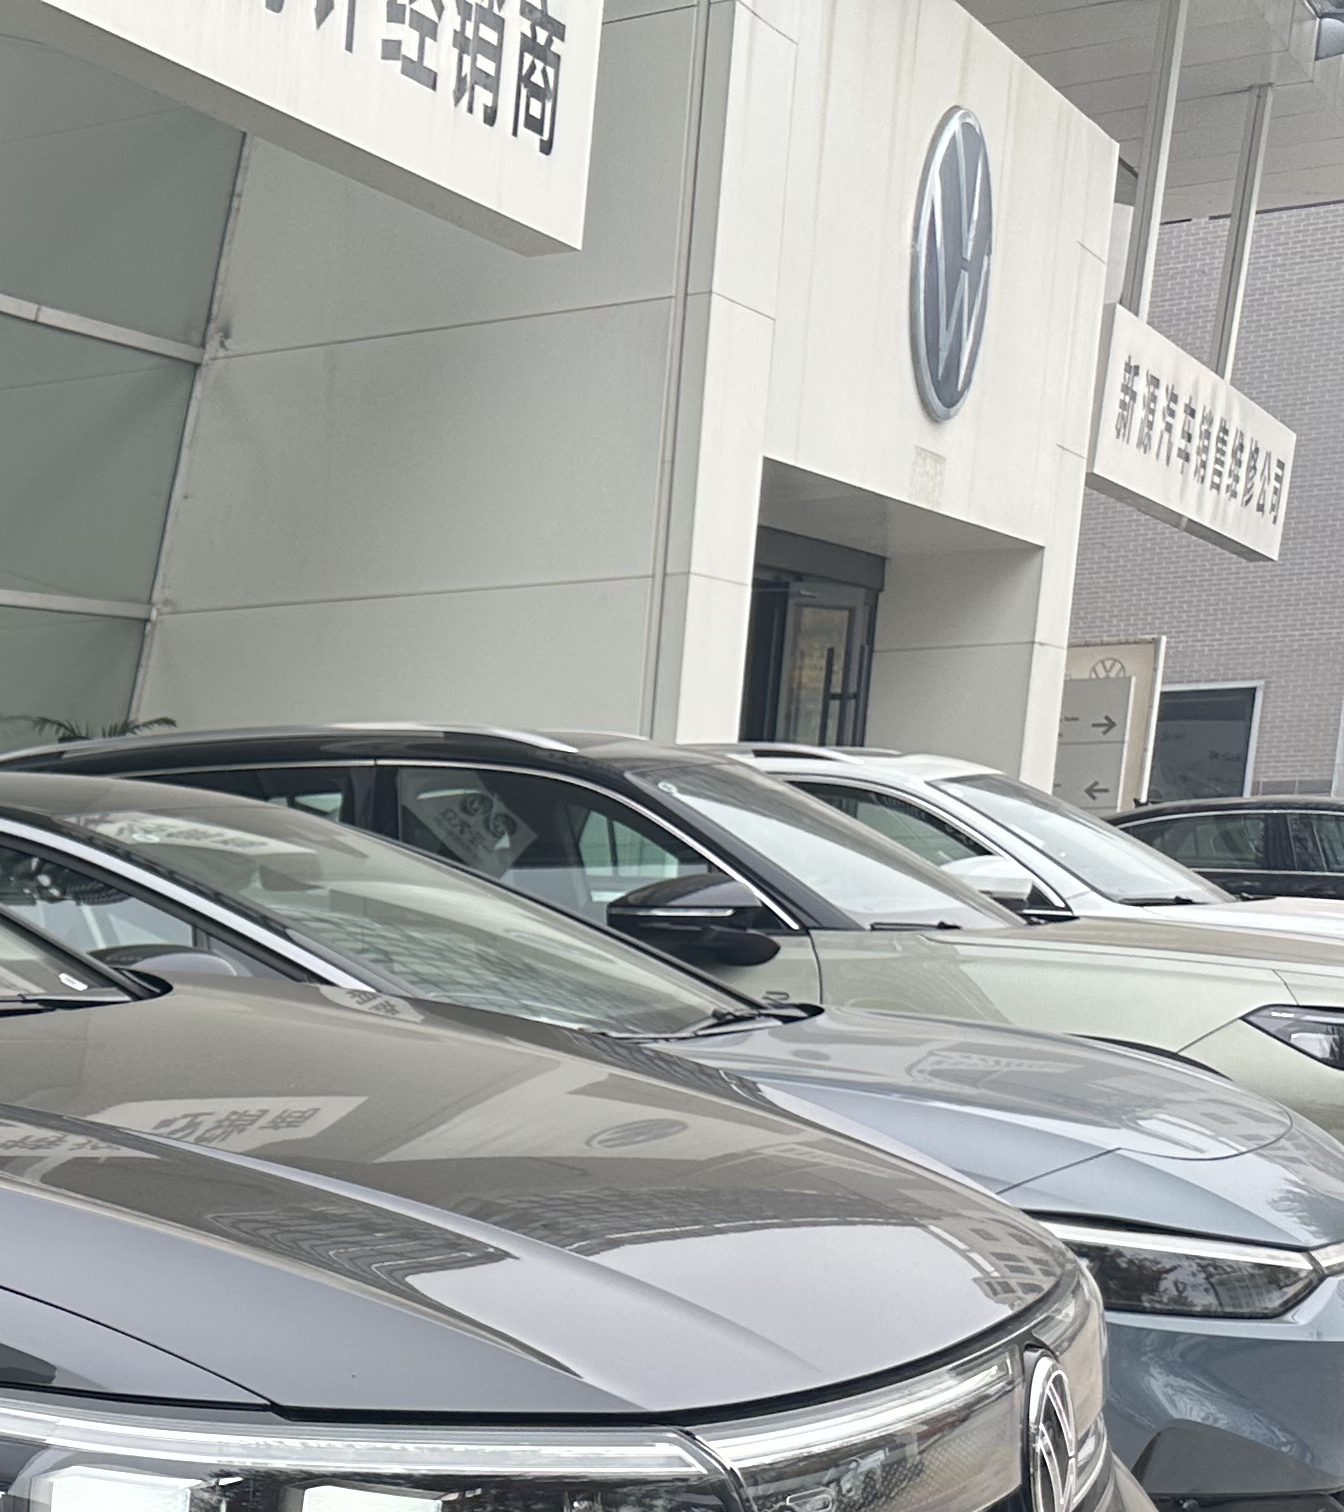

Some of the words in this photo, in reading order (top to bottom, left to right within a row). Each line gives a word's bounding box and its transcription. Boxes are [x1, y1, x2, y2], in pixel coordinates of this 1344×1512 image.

[1115, 355, 1285, 525] 新源汽车销售维修公司
